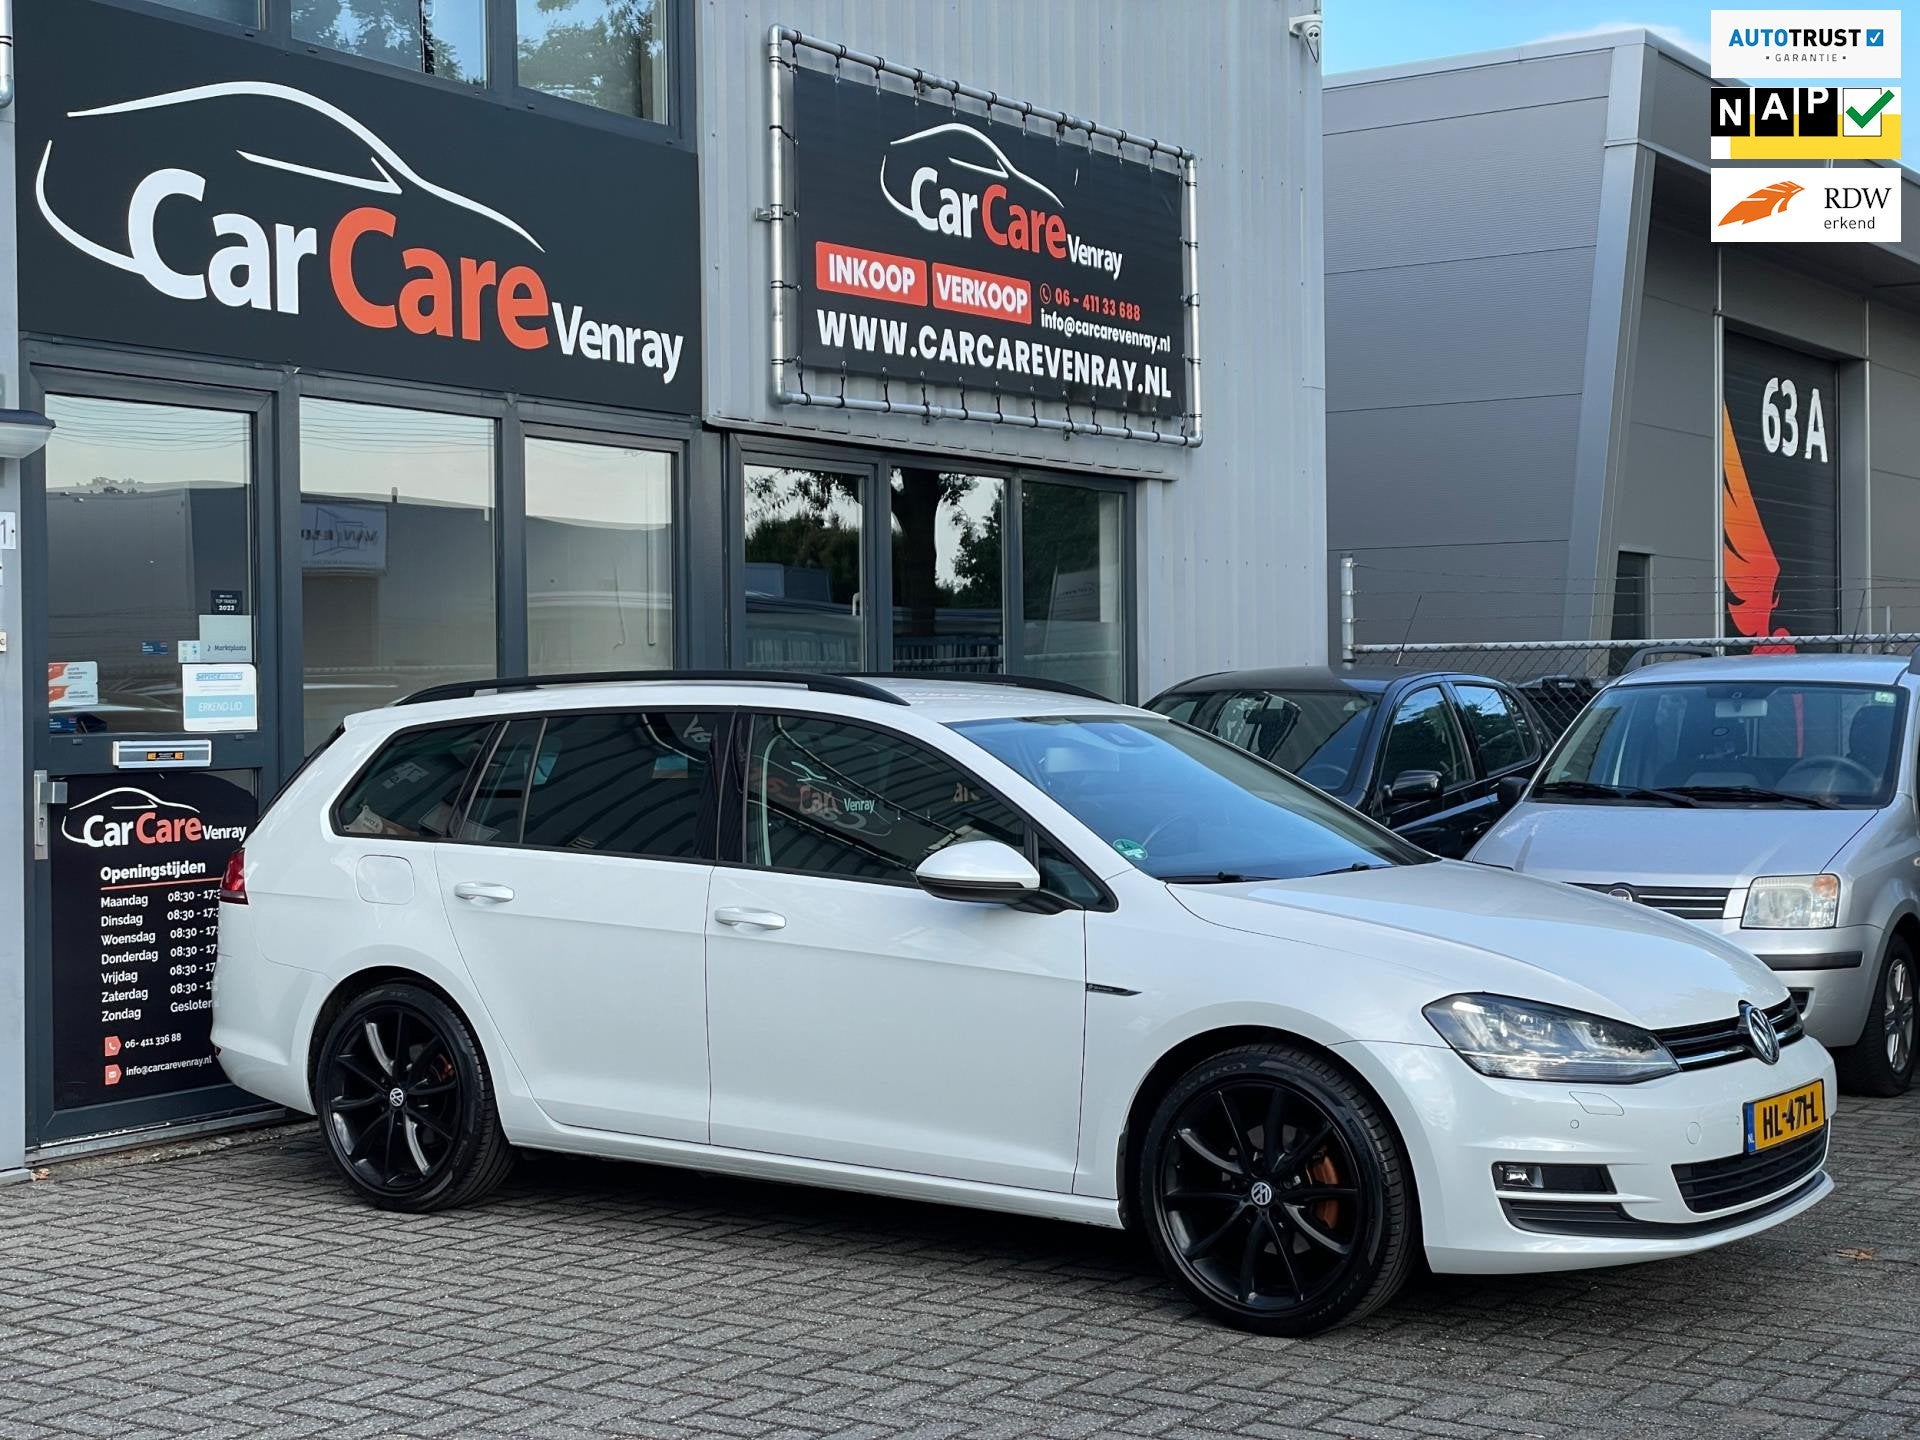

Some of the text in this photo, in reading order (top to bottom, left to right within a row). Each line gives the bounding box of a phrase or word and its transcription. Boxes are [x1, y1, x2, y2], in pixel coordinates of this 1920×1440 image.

[910, 166, 1123, 281] CarCare Venray
[128, 167, 684, 385] CarCare Venray
[828, 252, 916, 295] INKOOP
[936, 272, 1029, 315] VERKOOP
[1055, 287, 1071, 307] 06
[1082, 294, 1101, 313] 411
[1102, 297, 1117, 317] 33
[1119, 301, 1142, 322] 688
[1040, 307, 1171, 355] info@carcarevenray.nl
[816, 309, 1172, 399] WWW.CARCAREVENRAY.NL
[1762, 376, 1829, 463] 63 A
[82, 811, 247, 848] CarCare Venray
[100, 860, 206, 884] Openingstijden
[101, 895, 149, 908] Maandag
[167, 890, 195, 902] 08:30
[203, 889, 221, 901] 17:3
[101, 914, 143, 927] Dinsdag
[166, 909, 194, 921] 08:30
[203, 908, 219, 919] 17:
[101, 931, 156, 946] Woensdag
[169, 927, 197, 939] 08:30
[101, 950, 159, 965] Donderdag
[170, 945, 198, 957] 08:30
[205, 943, 217, 955] 17
[101, 970, 138, 985] Vrijdag
[169, 964, 197, 976] 08:30
[205, 962, 216, 973] 17
[101, 988, 149, 1003] Zaterdag
[170, 982, 198, 995] 08:30
[101, 1008, 142, 1022] Zondag
[140, 1037, 154, 1047] 411
[155, 1034, 170, 1046] 336
[171, 1032, 182, 1042] 88
[126, 1054, 213, 1076] info@carcarevenray.nl
